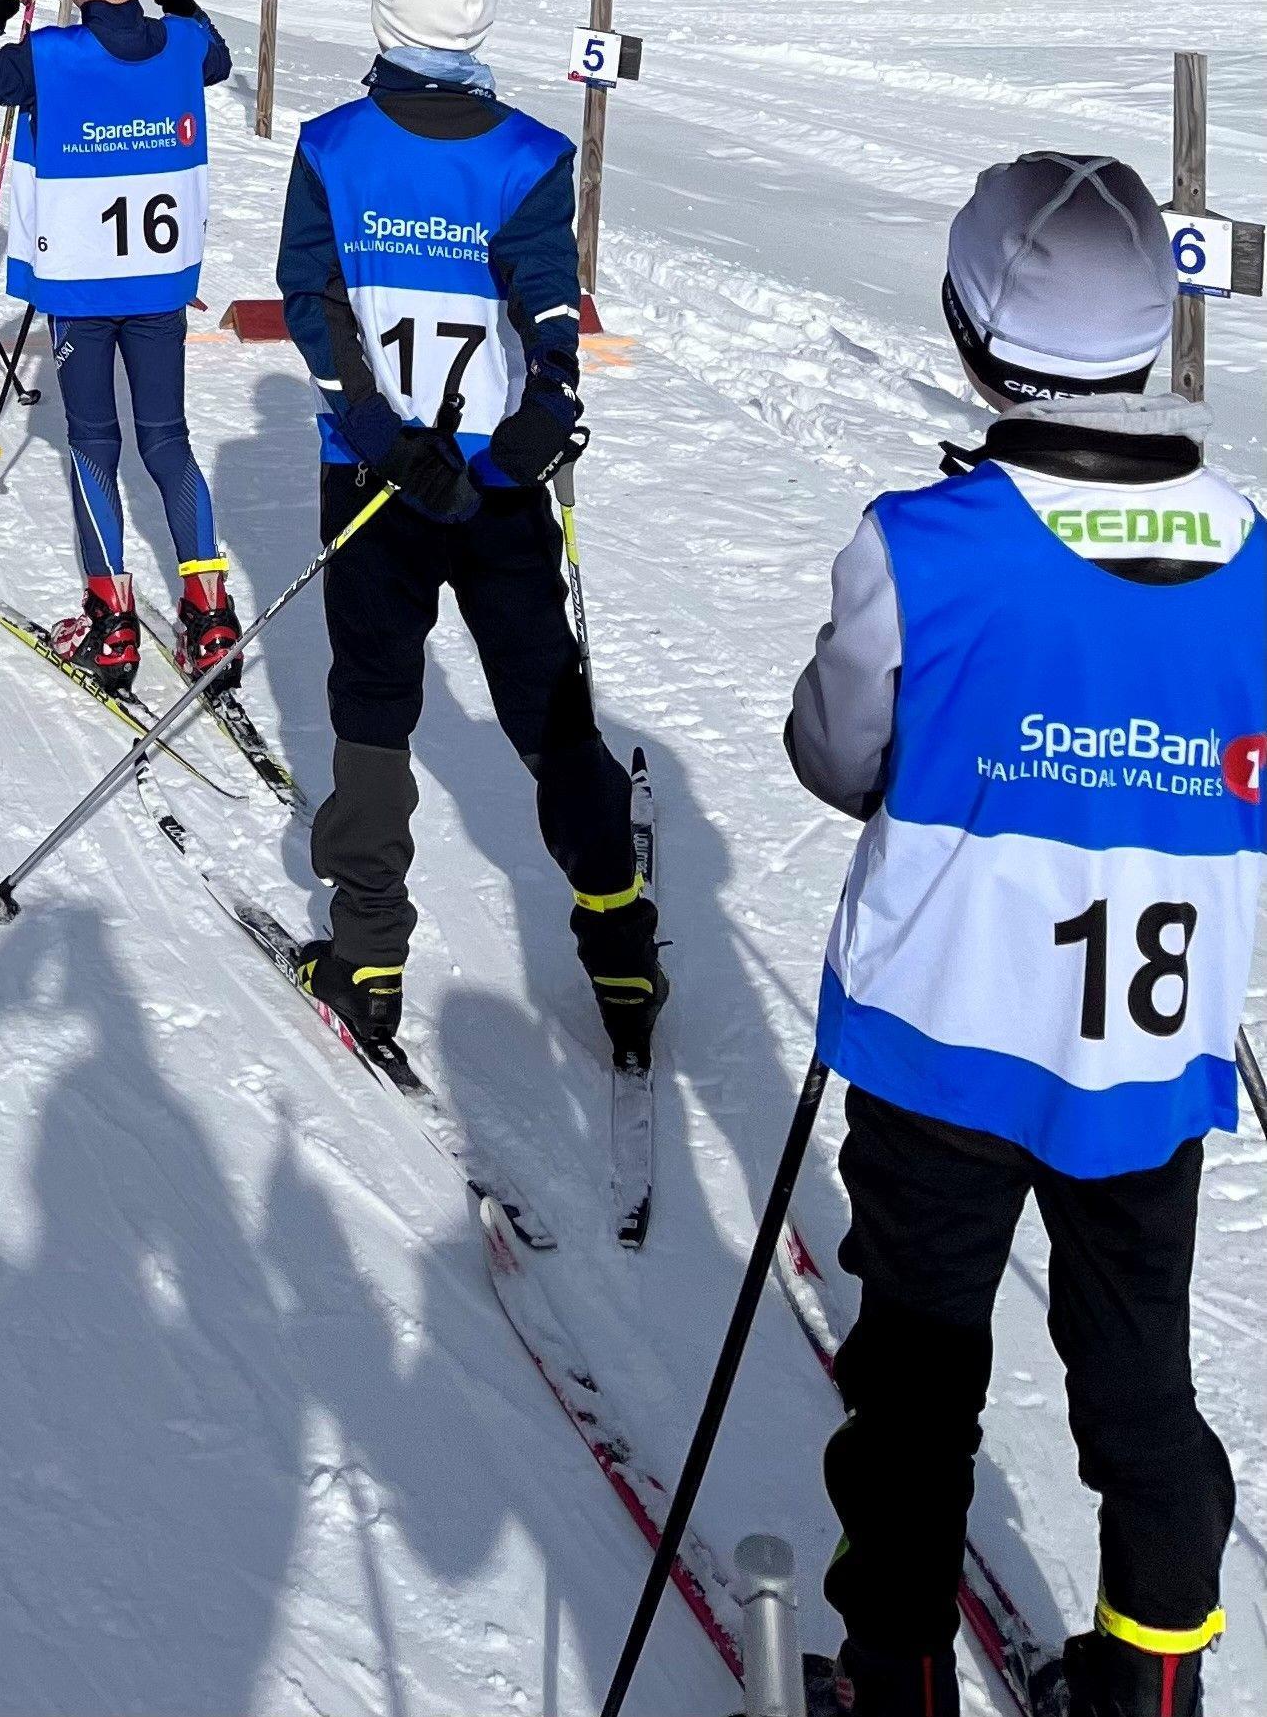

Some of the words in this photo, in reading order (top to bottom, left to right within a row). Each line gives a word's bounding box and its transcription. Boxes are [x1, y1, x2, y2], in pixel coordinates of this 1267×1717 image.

[582, 38, 605, 72] 5
[62, 141, 130, 154] HALLINGDAL
[131, 137, 177, 150] VALDRES
[82, 116, 177, 143] SpareBank
[183, 117, 192, 140] 1
[101, 193, 180, 257] 16
[363, 210, 490, 247] SpareBank
[427, 244, 490, 265] VALDRES
[1172, 227, 1207, 275] 6
[380, 316, 487, 398] 17
[1004, 379, 1082, 401] CRAF
[1036, 508, 1222, 549] GEDAL
[34, 642, 109, 706] FISCHER
[1020, 712, 1222, 768] SpareBank
[976, 755, 1117, 789] HALLINGDAL
[1122, 766, 1225, 798] VALDRES
[1054, 898, 1197, 1040] 18
